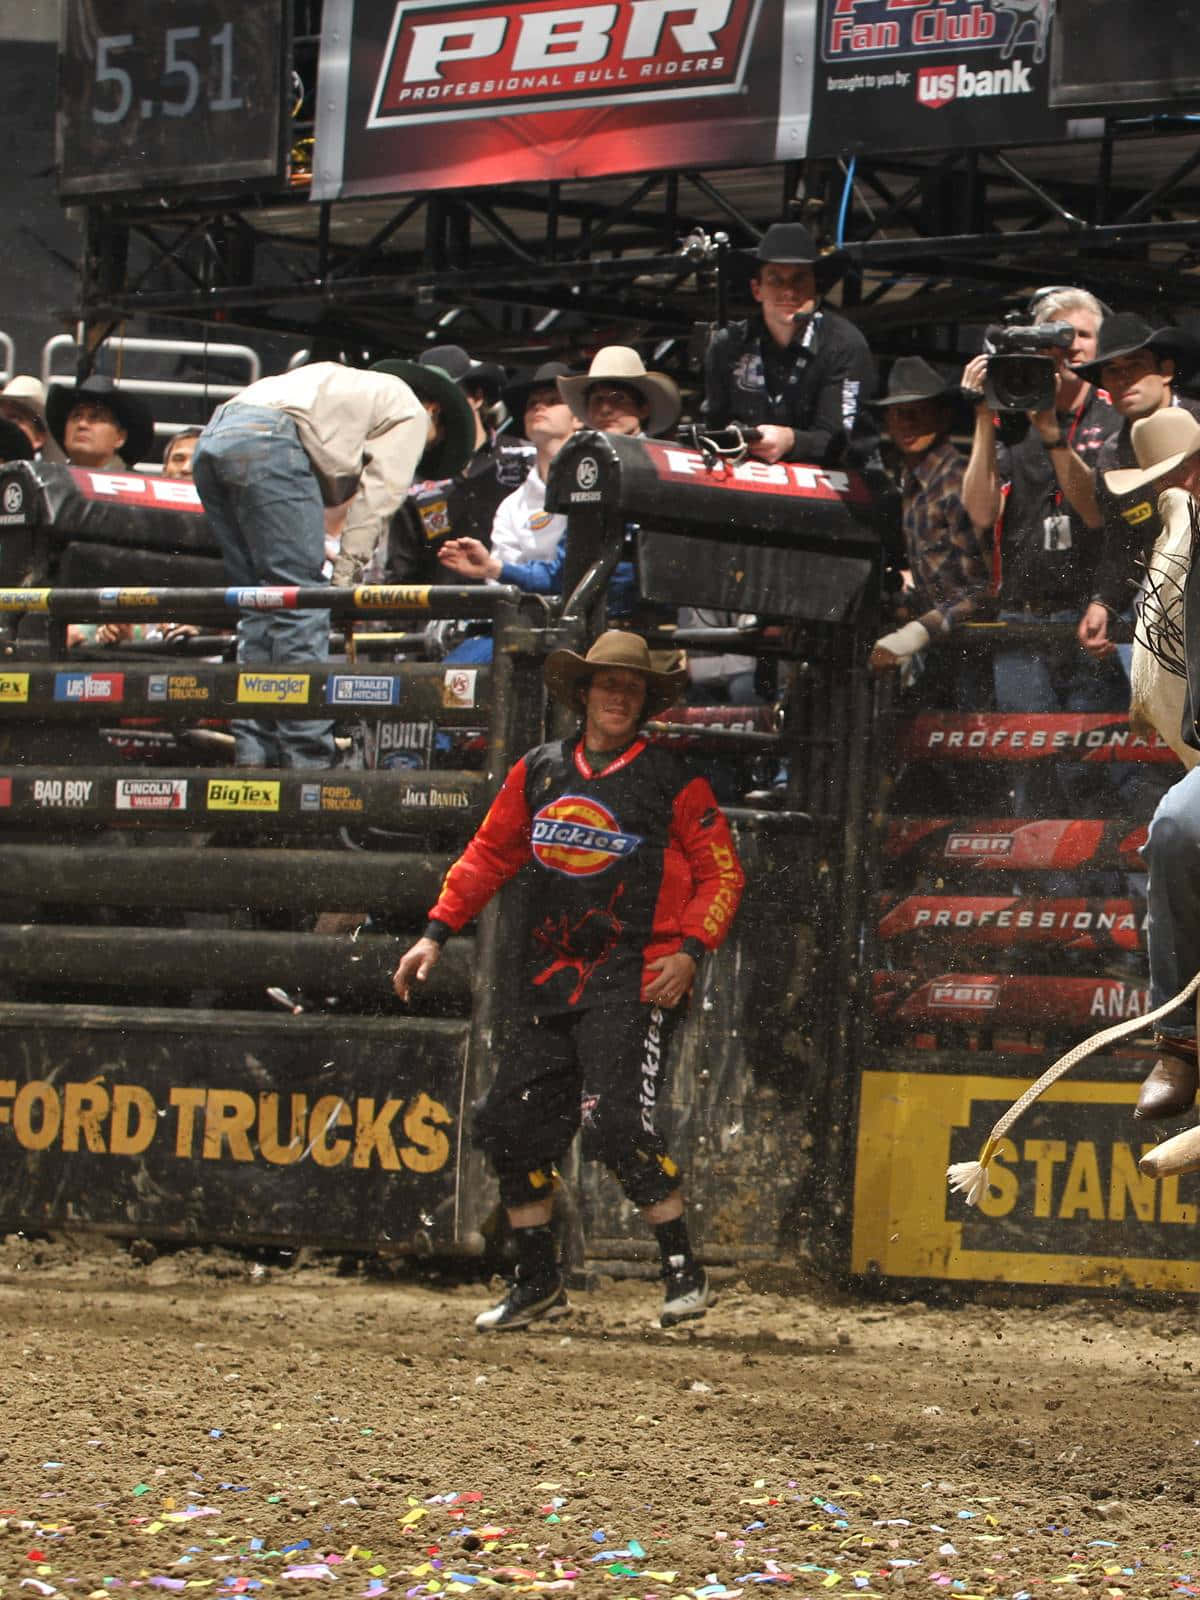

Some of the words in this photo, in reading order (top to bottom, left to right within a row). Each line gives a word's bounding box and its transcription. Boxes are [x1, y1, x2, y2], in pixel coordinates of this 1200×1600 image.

[830, 17, 900, 53] Fan
[912, 5, 996, 45] Club
[403, 0, 733, 83] PBR
[93, 22, 243, 124] 5.51
[399, 74, 561, 101] PROFESSIONAL
[574, 67, 628, 83] BULL
[640, 57, 725, 76] RIDERS
[827, 74, 864, 92] brought
[865, 75, 875, 88] to
[876, 74, 894, 89] you
[664, 450, 850, 491] PBR
[88, 473, 201, 504] PB
[571, 491, 602, 502] VERSUS
[0, 514, 25, 525] ERSUS
[169, 677, 197, 688] FORD
[169, 688, 209, 700] TRUCKS
[243, 676, 306, 700] Wrangler
[381, 722, 429, 749] BUILT
[34, 780, 62, 800] BAD
[64, 780, 93, 800] BOY
[125, 783, 171, 794] LINCOLN
[534, 822, 627, 850] Dickies
[949, 837, 1011, 850] PBR
[934, 988, 995, 1001] PBR
[170, 1086, 454, 1173] TRUCKS
